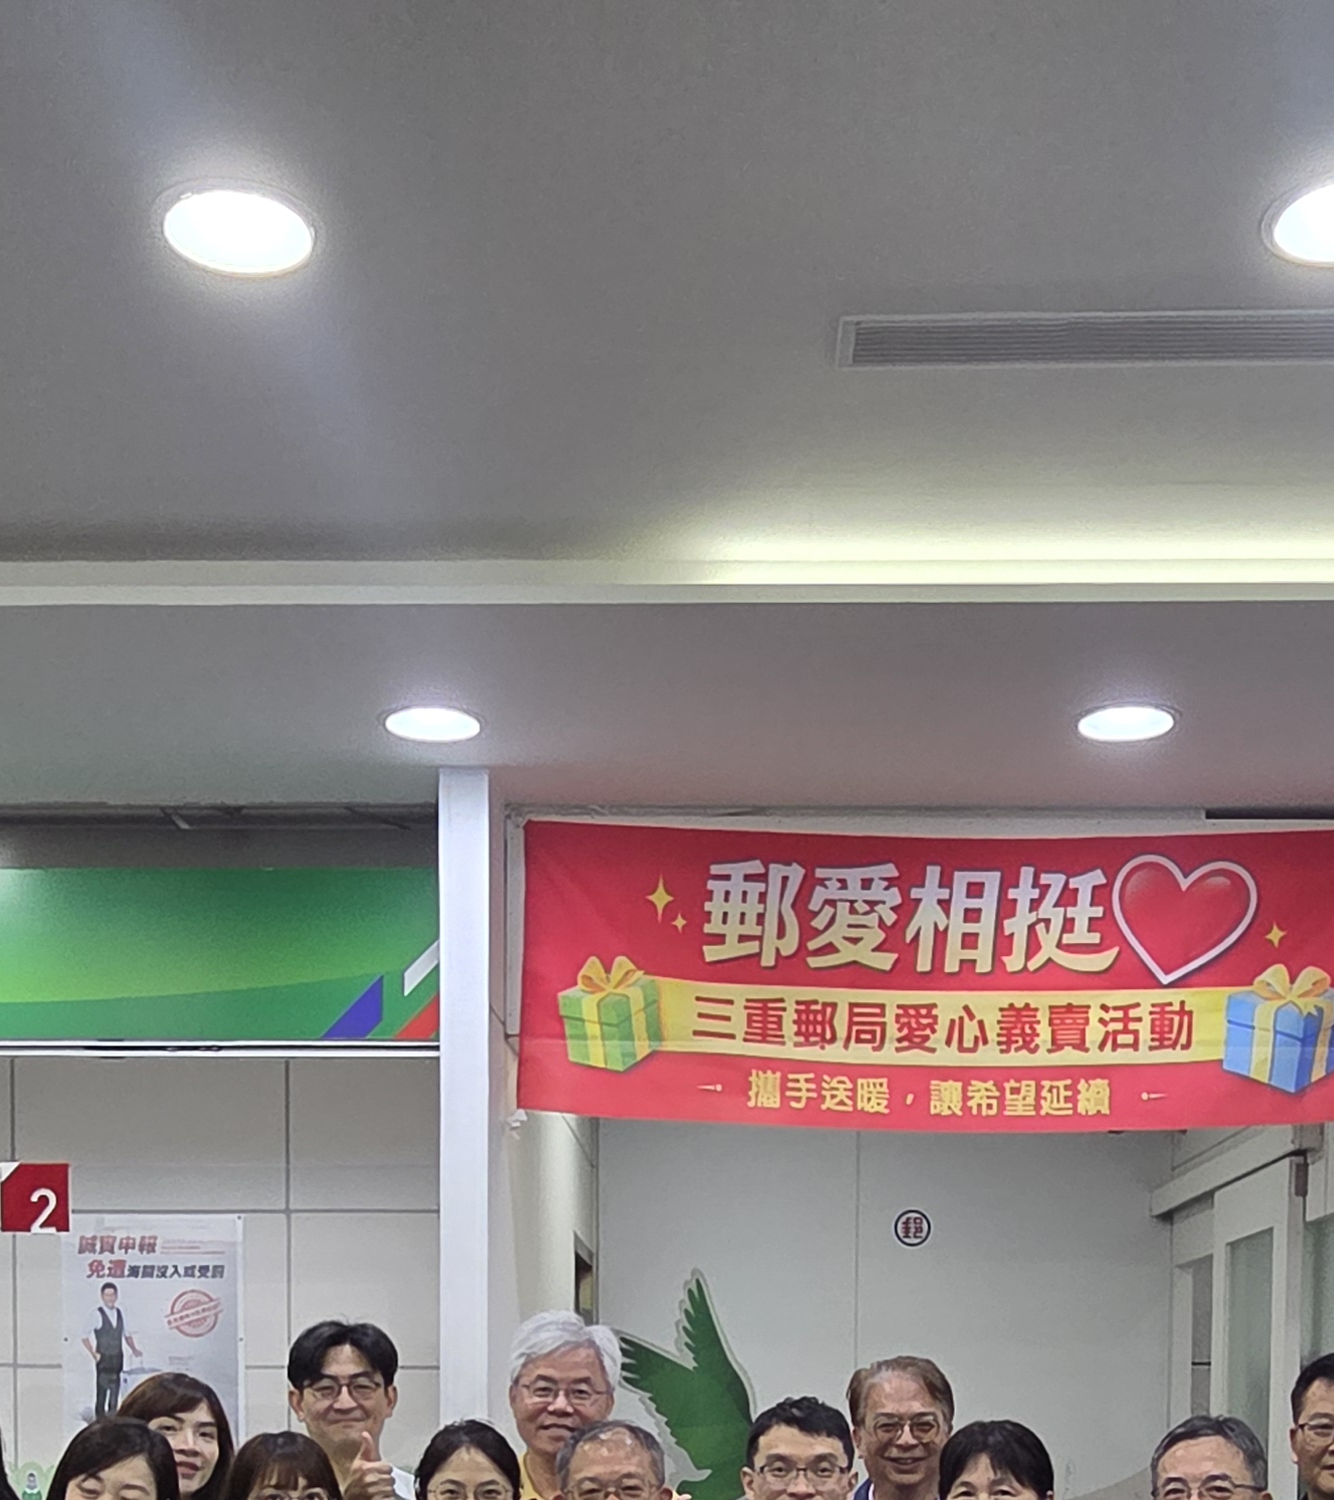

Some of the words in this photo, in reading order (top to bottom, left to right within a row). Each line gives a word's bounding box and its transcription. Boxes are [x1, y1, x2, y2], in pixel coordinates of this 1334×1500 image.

[701, 858, 1120, 976] 郵愛相挺
[691, 995, 1195, 1055] 三重郵局愛心義賣活動
[29, 1188, 58, 1234] 2
